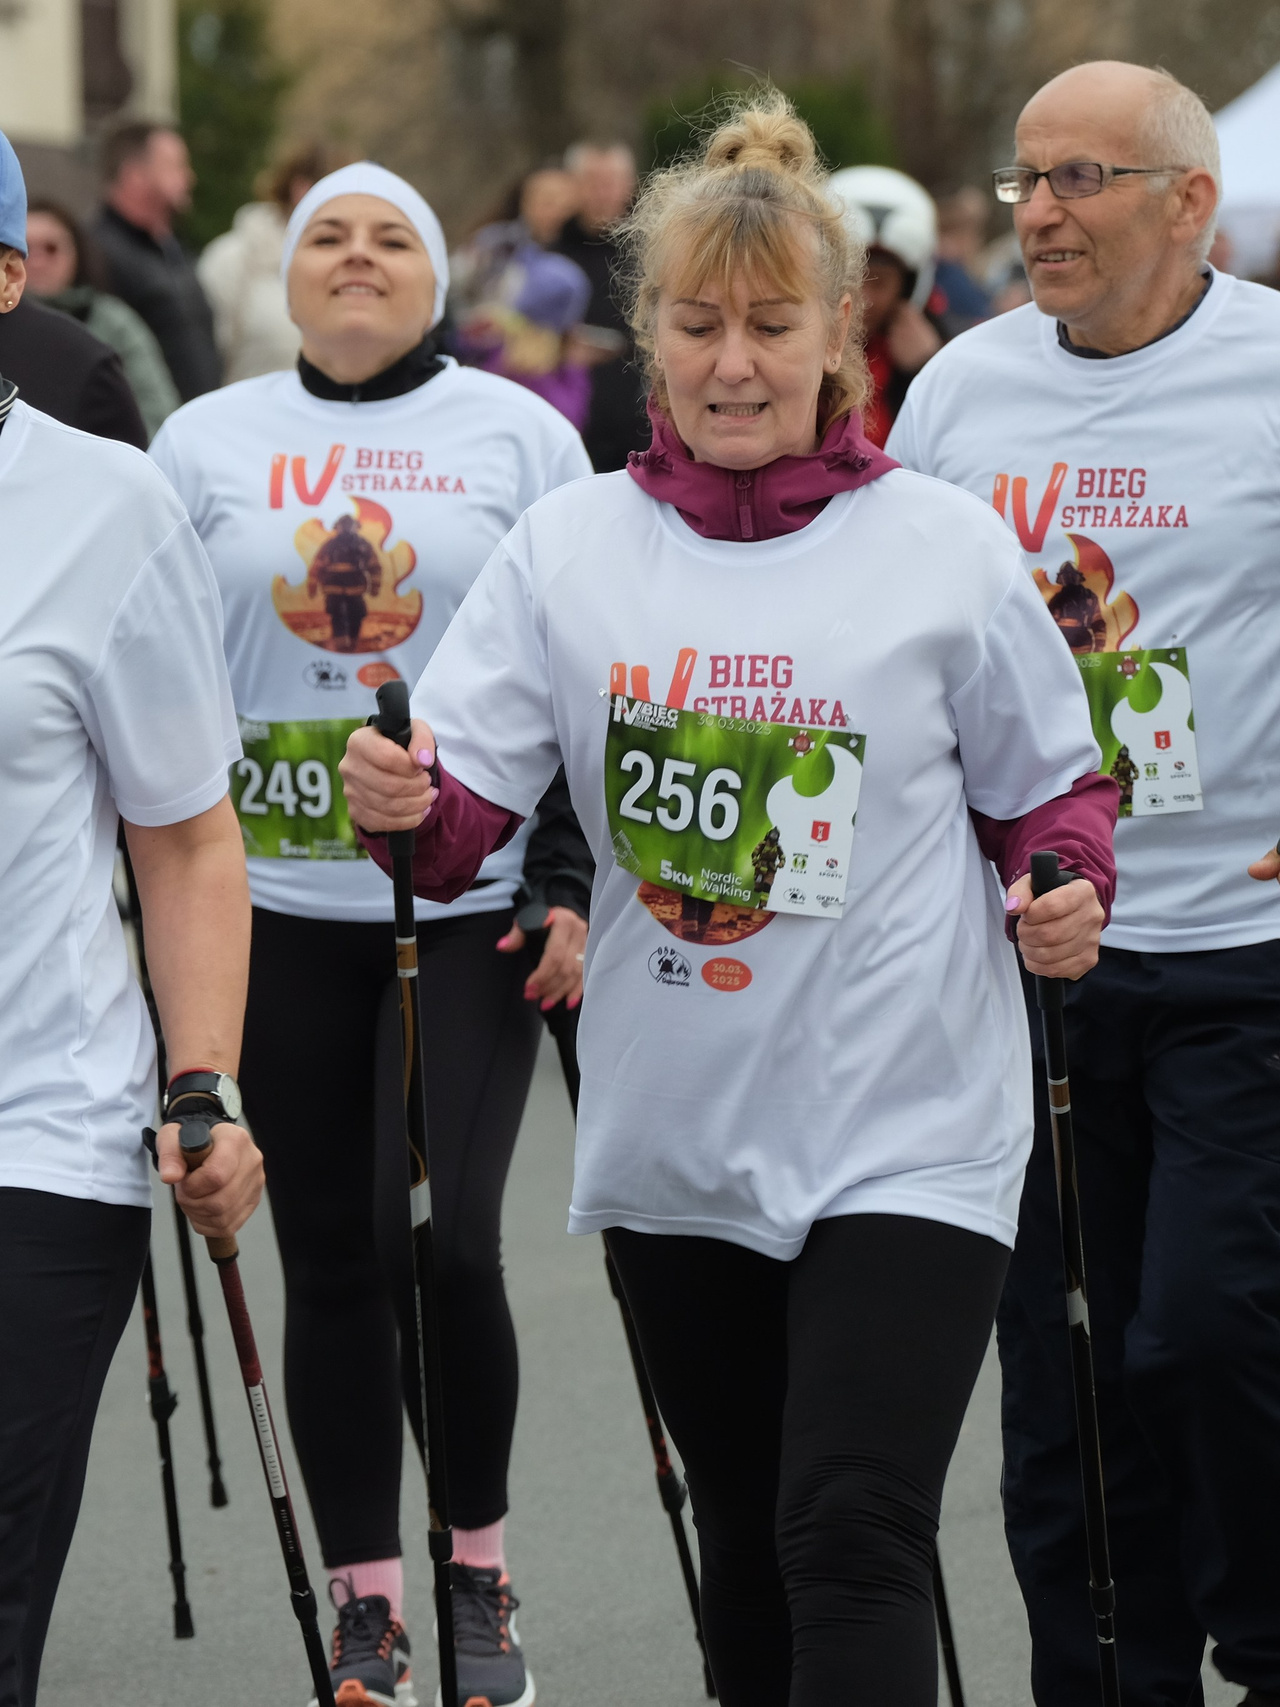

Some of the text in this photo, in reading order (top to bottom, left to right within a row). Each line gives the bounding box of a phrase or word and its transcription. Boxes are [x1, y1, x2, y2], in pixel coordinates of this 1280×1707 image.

[354, 448, 424, 470] BIEG
[269, 443, 346, 509] IV
[341, 471, 467, 494] STRAŻAKA
[1075, 468, 1146, 498] BIEG
[1060, 501, 1189, 528] STRAŻAKA
[708, 655, 793, 688] BIEG
[613, 695, 643, 726] IV
[641, 702, 678, 721] BIEG
[693, 691, 847, 727] STRAŻAKA
[697, 713, 772, 736] 30.03.2025
[237, 757, 331, 818] 249
[619, 749, 741, 841] 256
[660, 859, 693, 887] 5KM
[700, 867, 743, 886] Nordic
[700, 879, 751, 901] Walking
[712, 963, 744, 975] 30.03.
[712, 974, 740, 985] 2025
